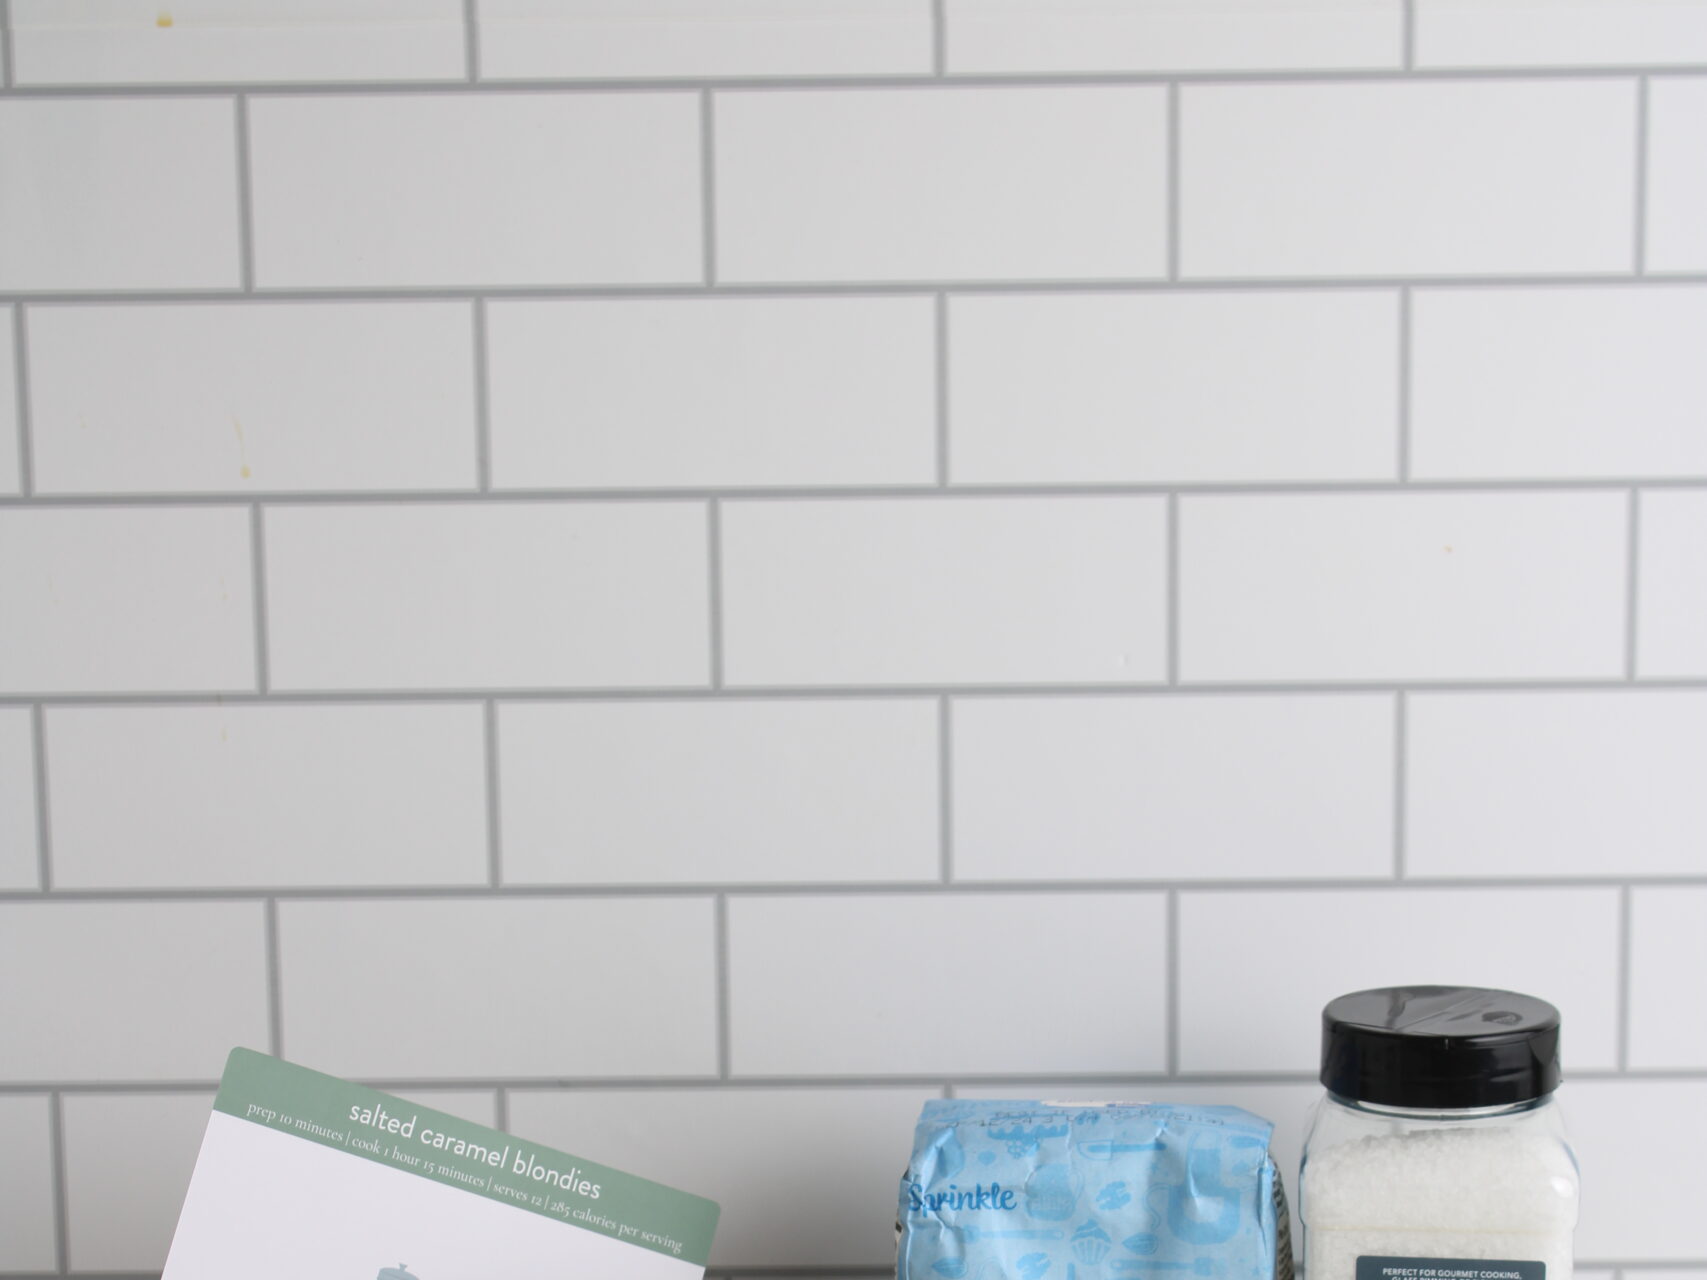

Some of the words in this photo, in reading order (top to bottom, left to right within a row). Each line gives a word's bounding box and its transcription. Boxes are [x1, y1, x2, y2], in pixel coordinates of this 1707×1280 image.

[247, 1103, 276, 1123] prep
[279, 1114, 292, 1125] 10
[295, 1117, 344, 1142] minutes
[352, 1137, 381, 1156] cook
[392, 1145, 421, 1167] hour
[423, 1160, 435, 1174] 15
[438, 1165, 485, 1188] minutes
[493, 1183, 528, 1202] serves
[531, 1196, 542, 1207] 12
[550, 1201, 570, 1218] 285
[572, 1208, 617, 1231] calories
[618, 1224, 639, 1237] per
[641, 1230, 683, 1255] serving
[349, 1104, 417, 1138] salted
[420, 1127, 510, 1169] caramel
[513, 1150, 601, 1200] blondies
[908, 1183, 1017, 1217] Sprinkle
[1382, 1268, 1417, 1277] PERFECT
[1419, 1269, 1437, 1277] FOR
[1437, 1269, 1479, 1279] GOURMET
